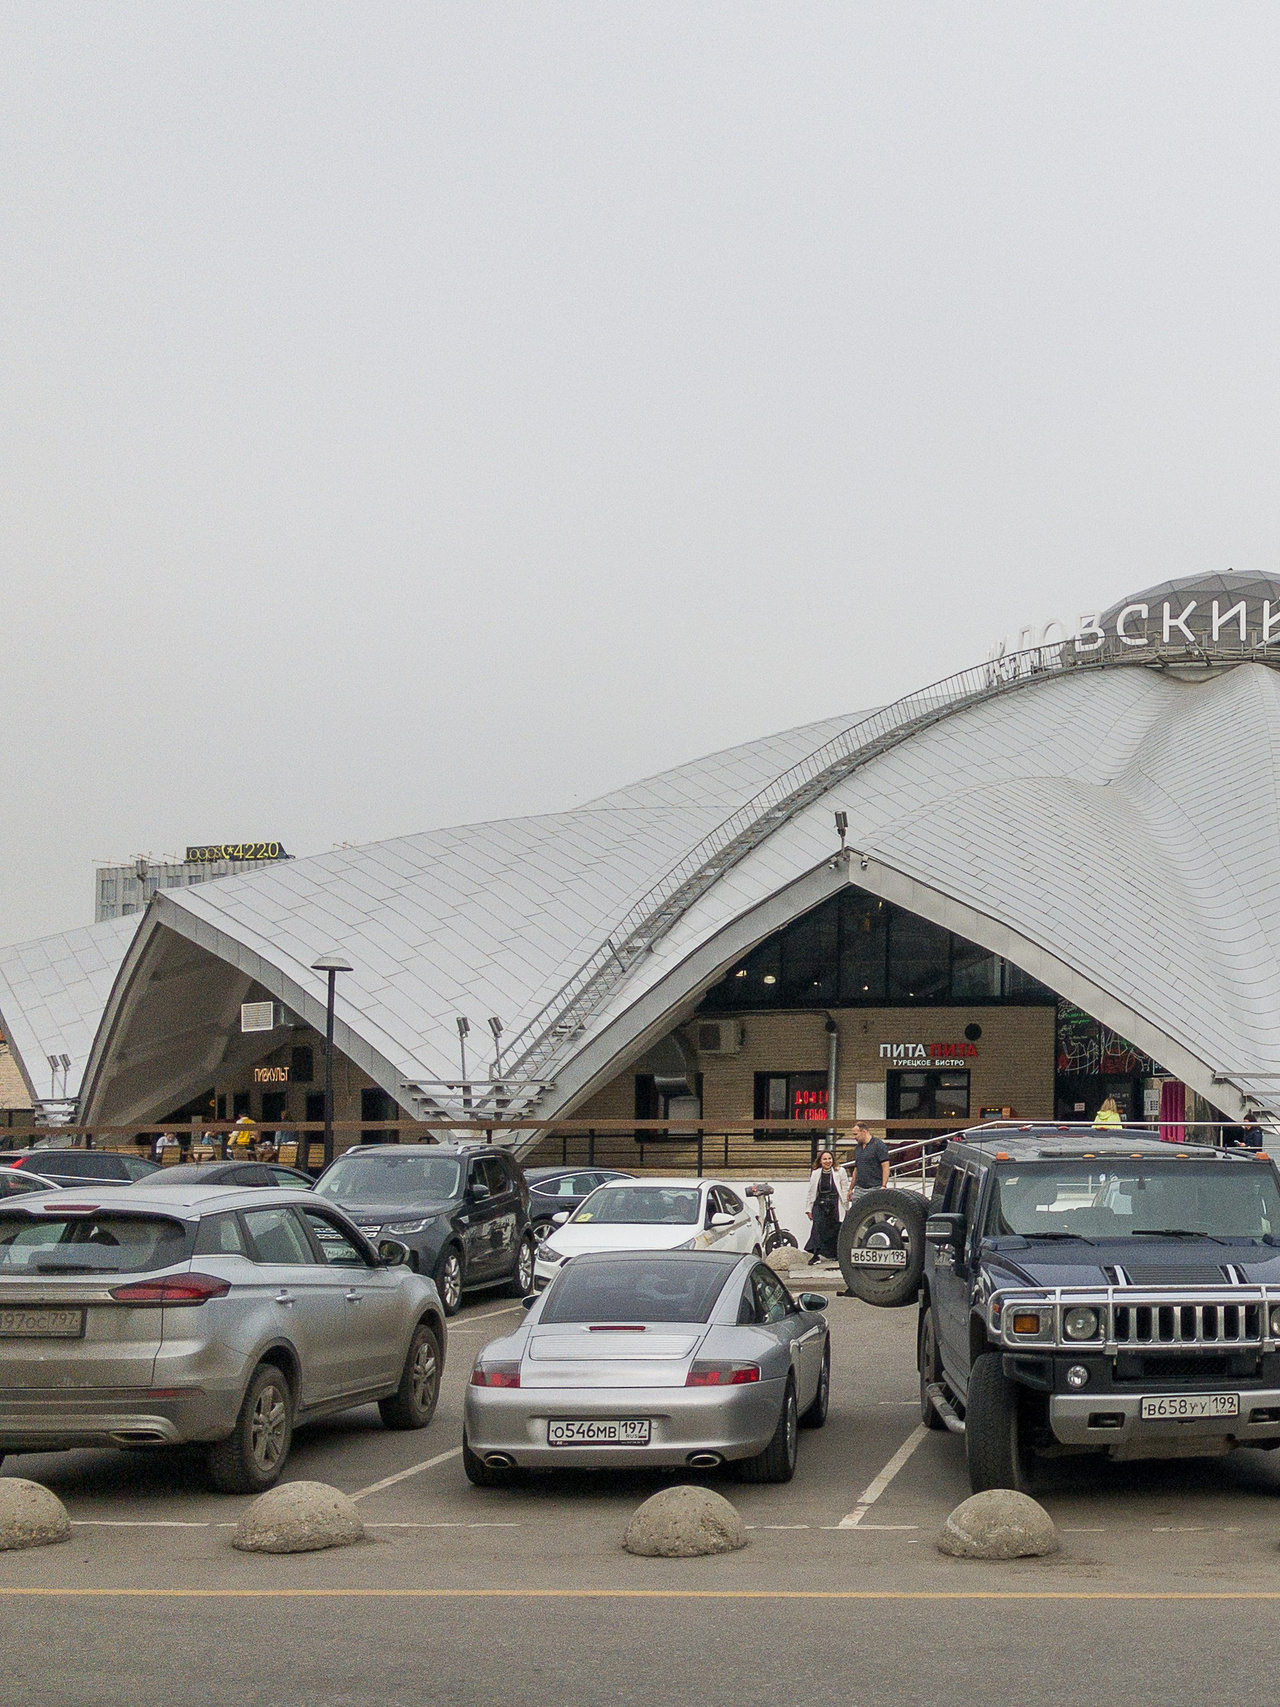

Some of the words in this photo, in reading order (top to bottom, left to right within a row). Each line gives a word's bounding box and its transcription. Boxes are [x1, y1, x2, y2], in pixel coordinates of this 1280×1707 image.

[879, 1044, 927, 1058] ПИТА
[929, 1043, 979, 1057] ПИТА
[892, 1059, 932, 1067] ТУРЕЦКОЕ
[935, 1059, 965, 1067] БИСТРО
[891, 1250, 905, 1260] 199
[49, 1312, 77, 1326] 797
[1147, 1399, 1208, 1416] В658УУ
[1212, 1396, 1234, 1409] 199
[554, 1422, 617, 1439] О546МВ
[621, 1422, 645, 1434] 197
